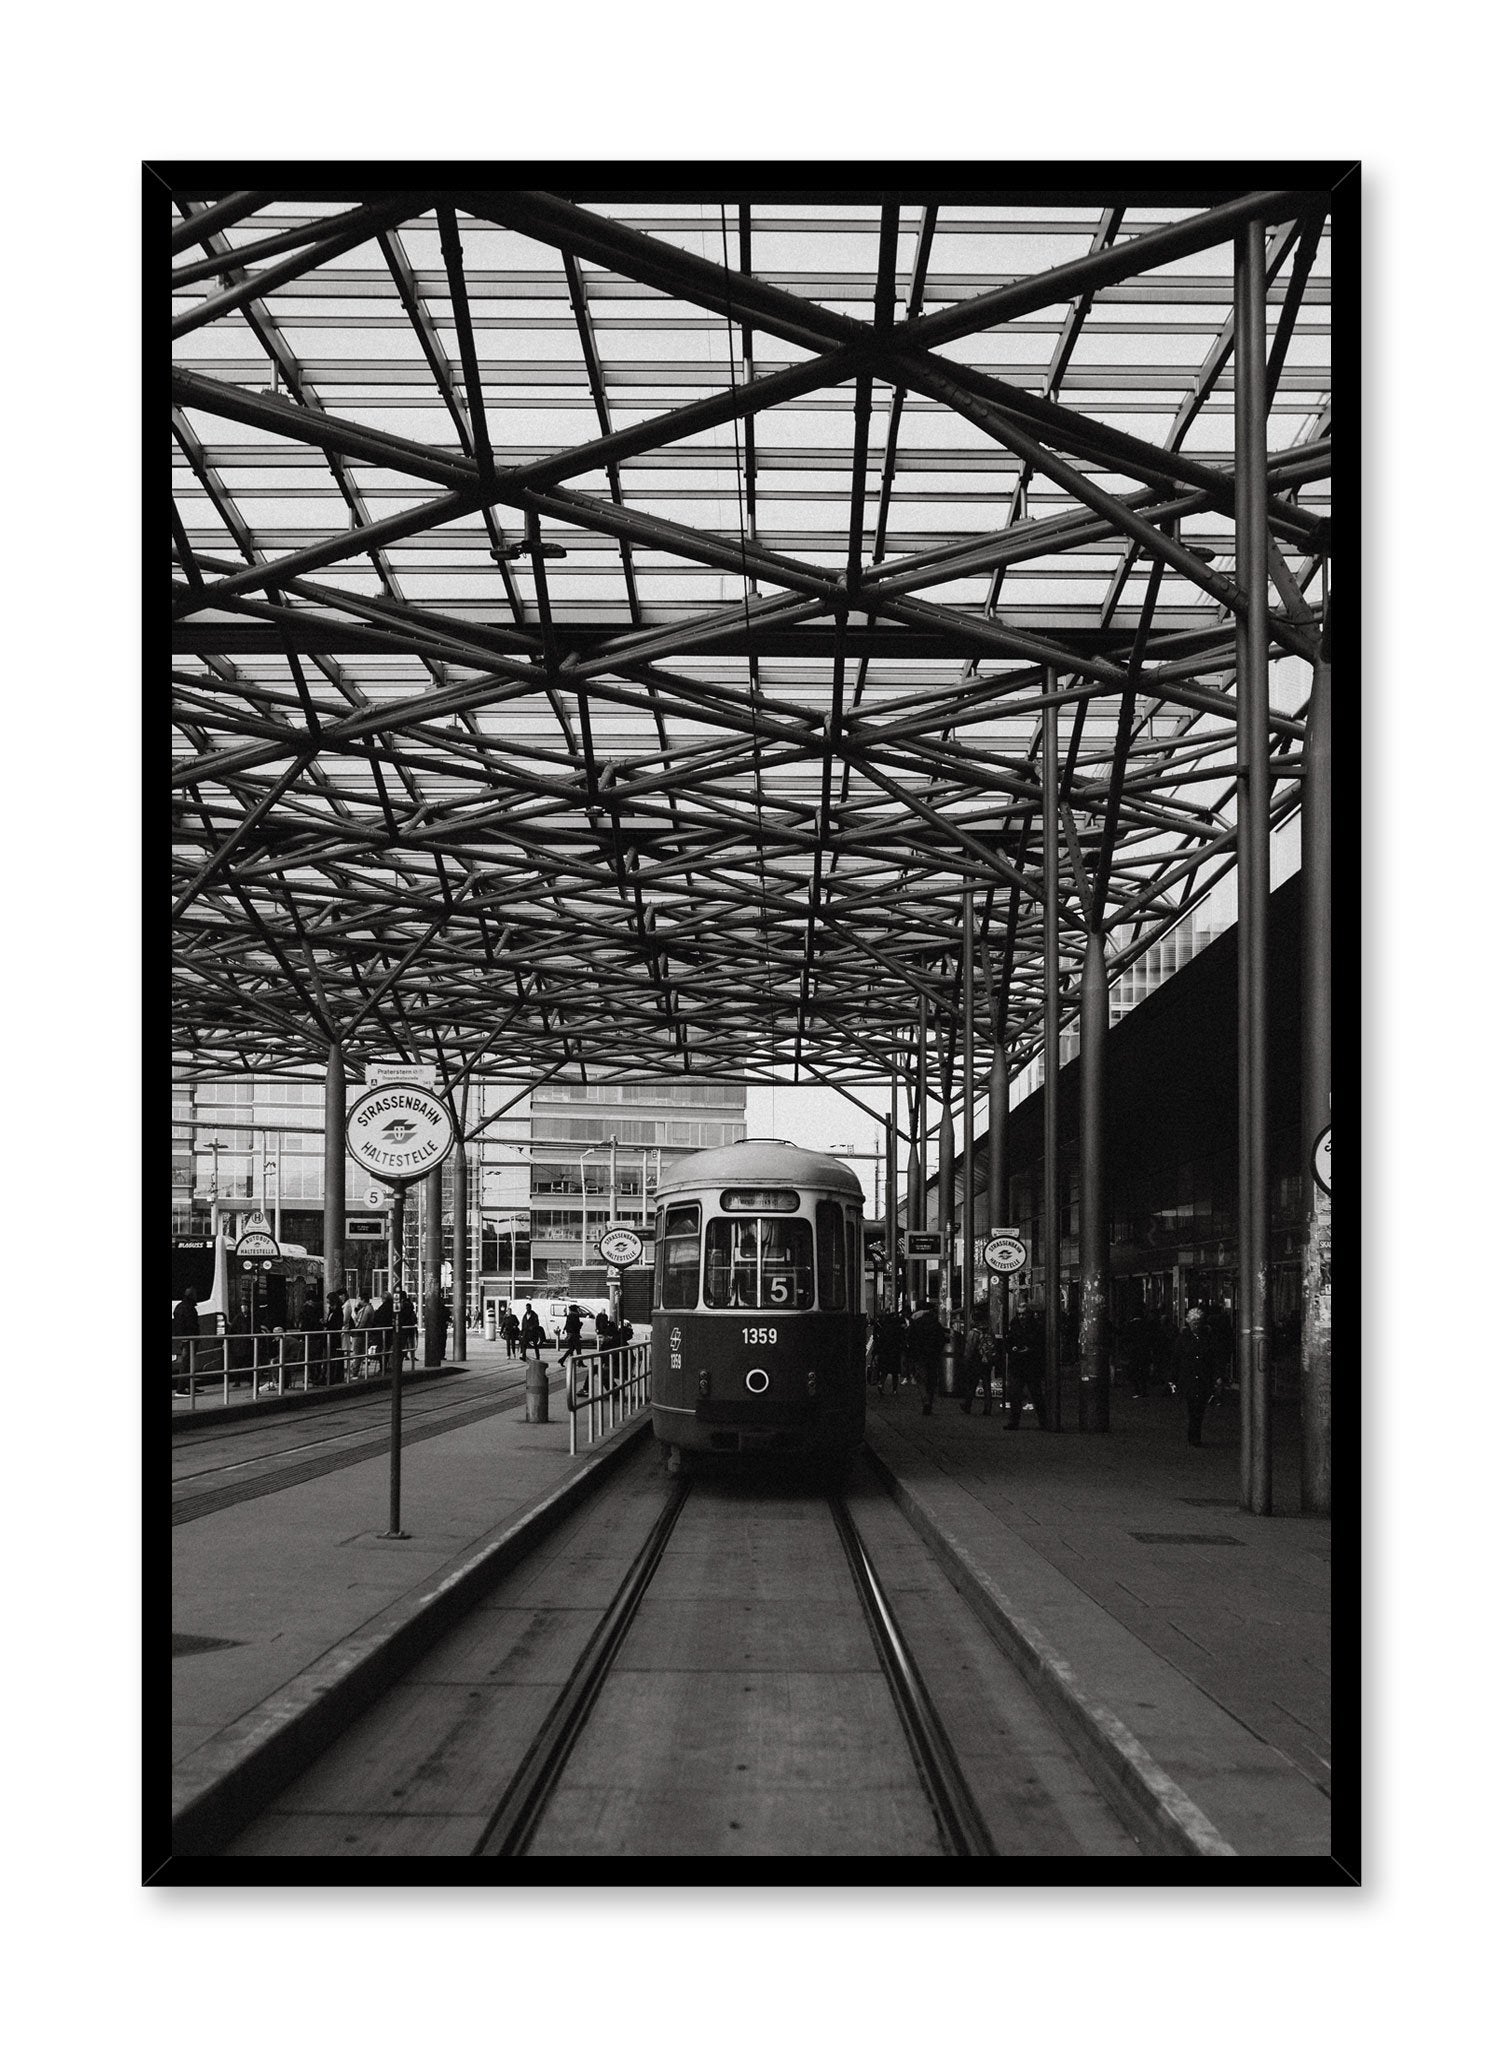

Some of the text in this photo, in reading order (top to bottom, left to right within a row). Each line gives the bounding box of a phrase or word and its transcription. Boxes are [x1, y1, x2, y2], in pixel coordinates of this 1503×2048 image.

[357, 1095, 442, 1127] STRASSENBAHN
[361, 1139, 438, 1167] HALTESTELLE
[369, 1191, 378, 1204] 5
[254, 1214, 261, 1222] H
[245, 1235, 270, 1245] AUTOBUS
[604, 1232, 638, 1245] STRASSENBAHN
[988, 1240, 1022, 1253] STRASSENBAHN
[606, 1250, 637, 1261] HALTESTELLE
[990, 1257, 1021, 1269] HALTESTELLE
[770, 1277, 788, 1303] 5
[742, 1328, 777, 1344] 1359
